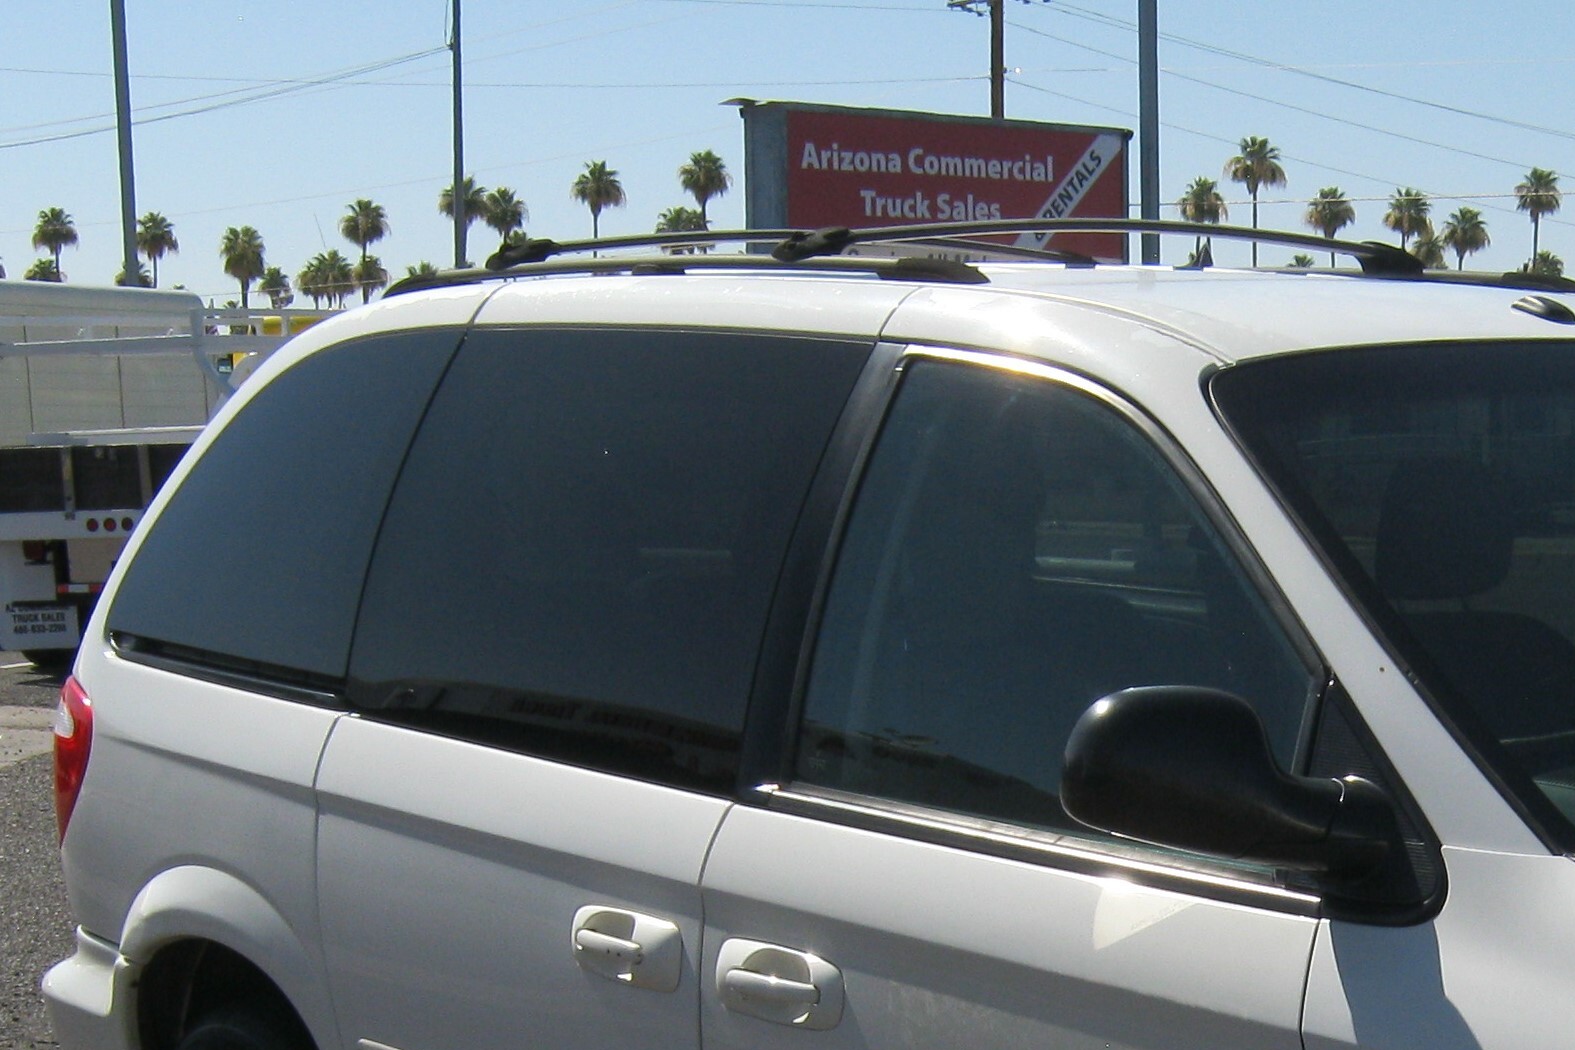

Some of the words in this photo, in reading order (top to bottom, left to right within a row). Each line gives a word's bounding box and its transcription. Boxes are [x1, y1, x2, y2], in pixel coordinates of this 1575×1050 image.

[801, 143, 901, 174] Arizona
[908, 148, 1054, 182] Commercial
[860, 190, 931, 220] Truck
[937, 193, 1001, 221] Sales
